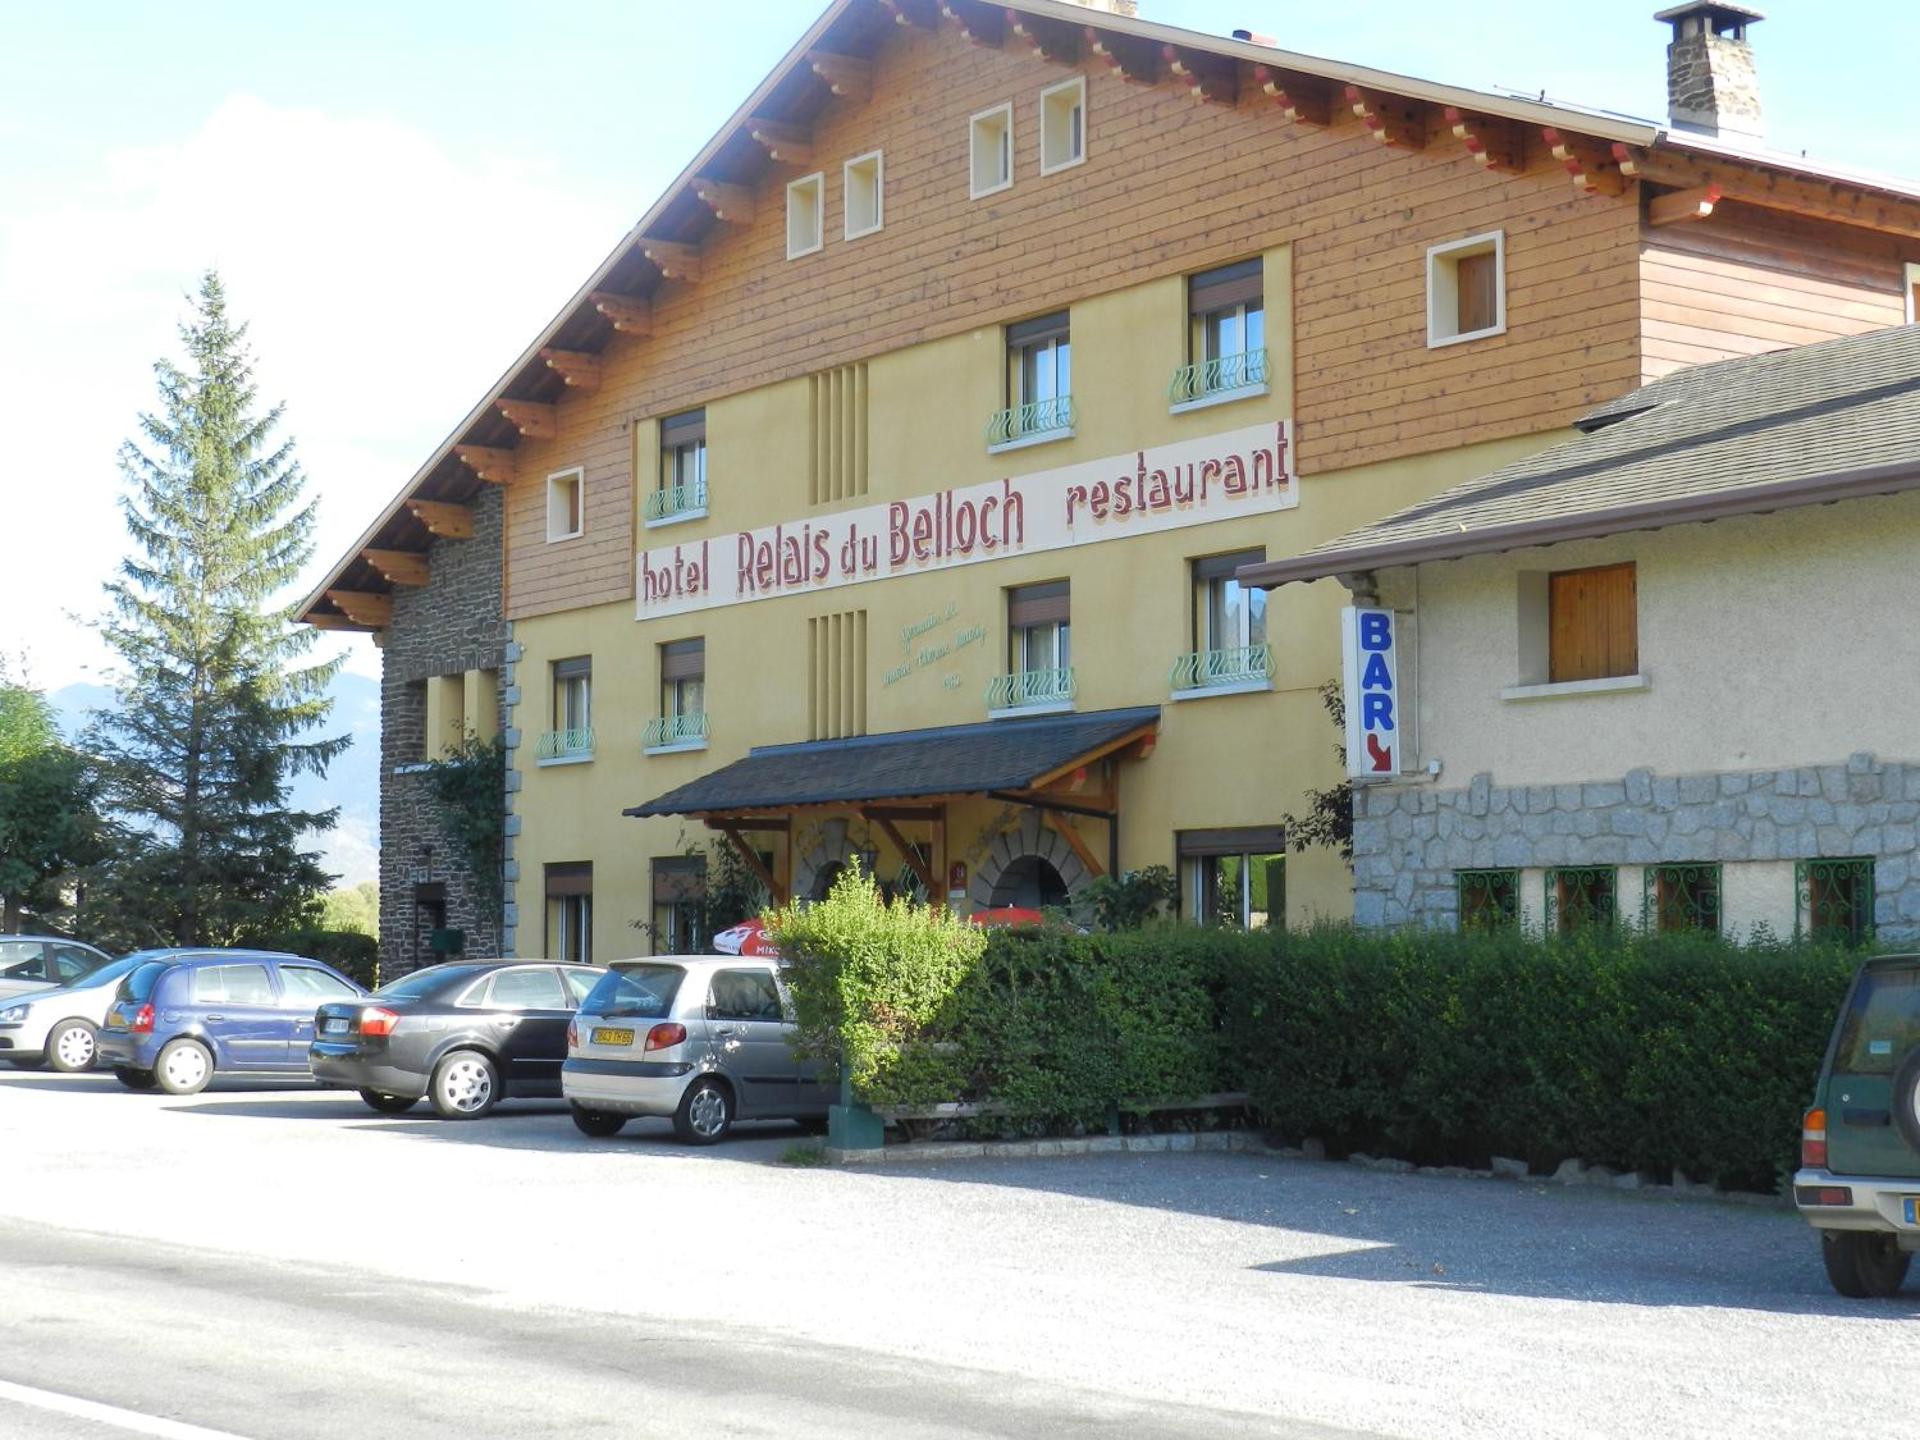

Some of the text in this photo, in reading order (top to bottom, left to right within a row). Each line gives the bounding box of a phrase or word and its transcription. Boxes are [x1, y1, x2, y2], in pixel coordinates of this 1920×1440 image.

[643, 420, 1290, 601] hotel Relais du Belloch restaurant
[1360, 612, 1395, 731] BAR
